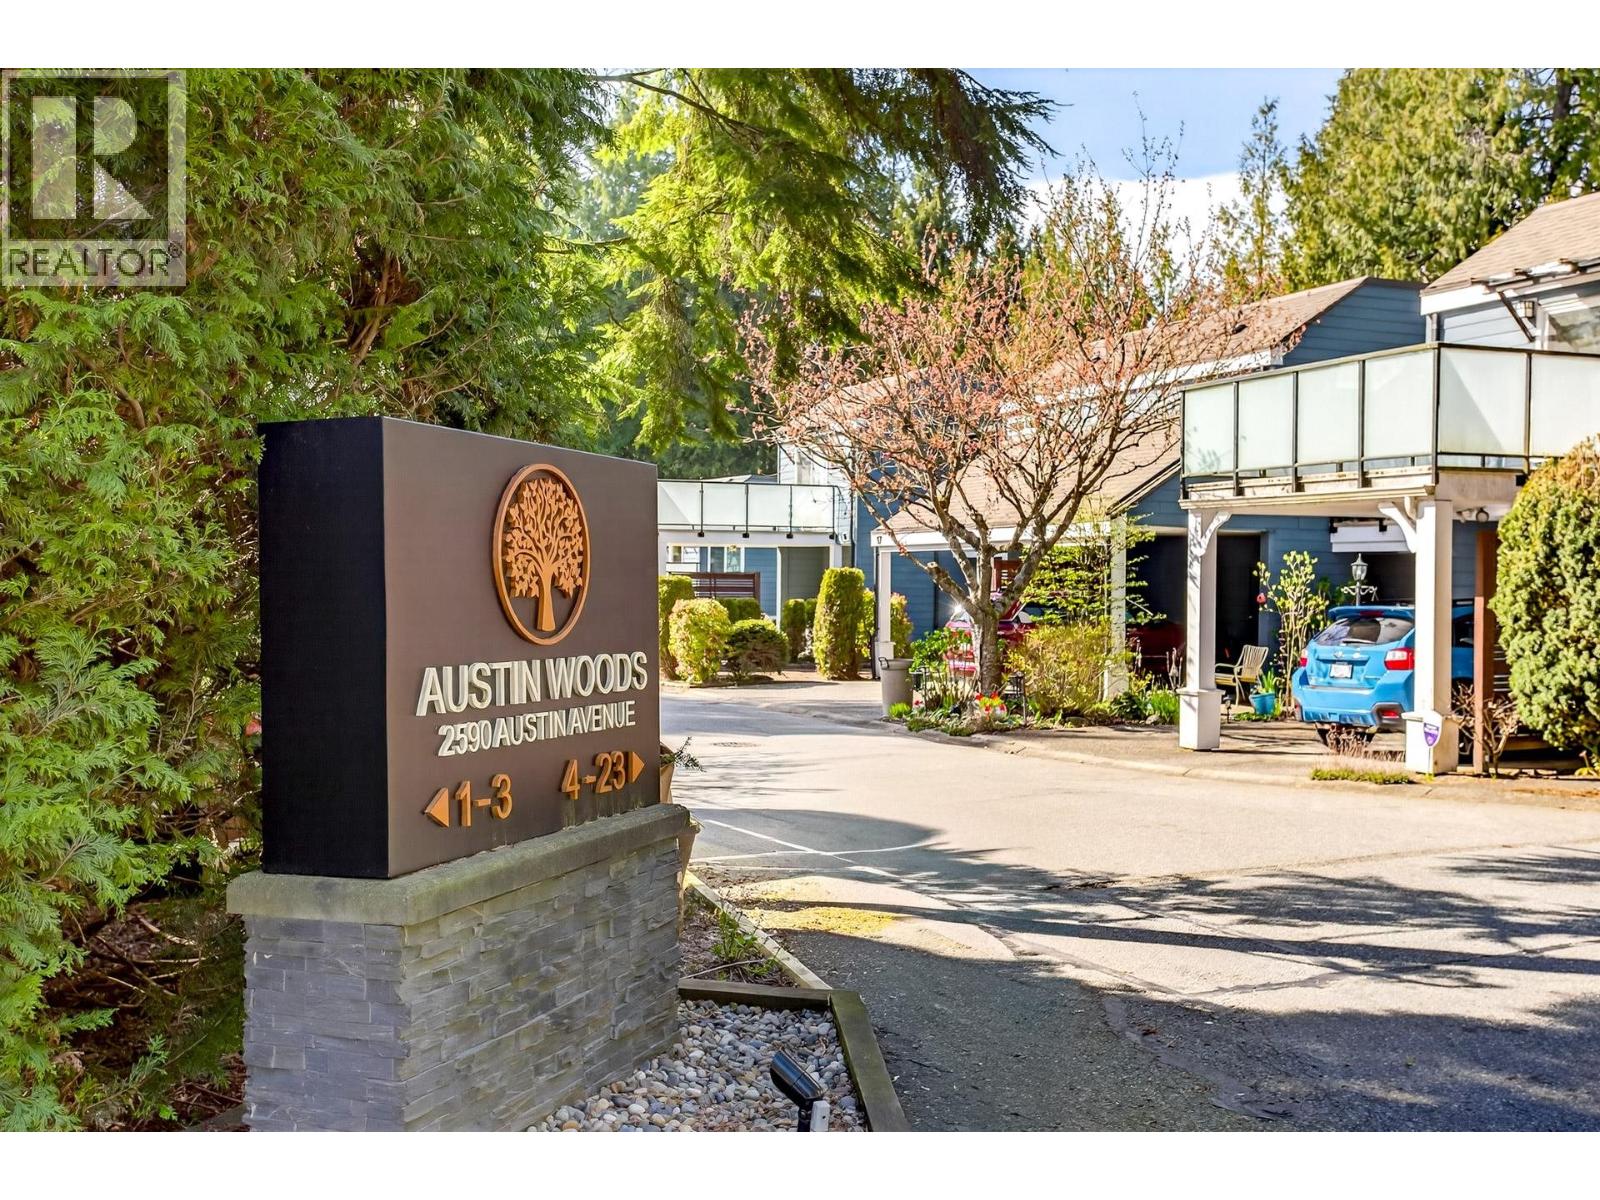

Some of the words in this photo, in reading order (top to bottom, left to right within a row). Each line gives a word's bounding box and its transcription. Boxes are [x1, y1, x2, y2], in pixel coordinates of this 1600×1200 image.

[415, 659, 541, 717] AUSTIN
[545, 651, 648, 700] WOODS
[437, 719, 493, 757] 2590
[492, 710, 567, 748] AUSTIN
[568, 700, 636, 736] AVENUE
[455, 773, 513, 827] 1-3
[561, 751, 627, 800] 4-23
